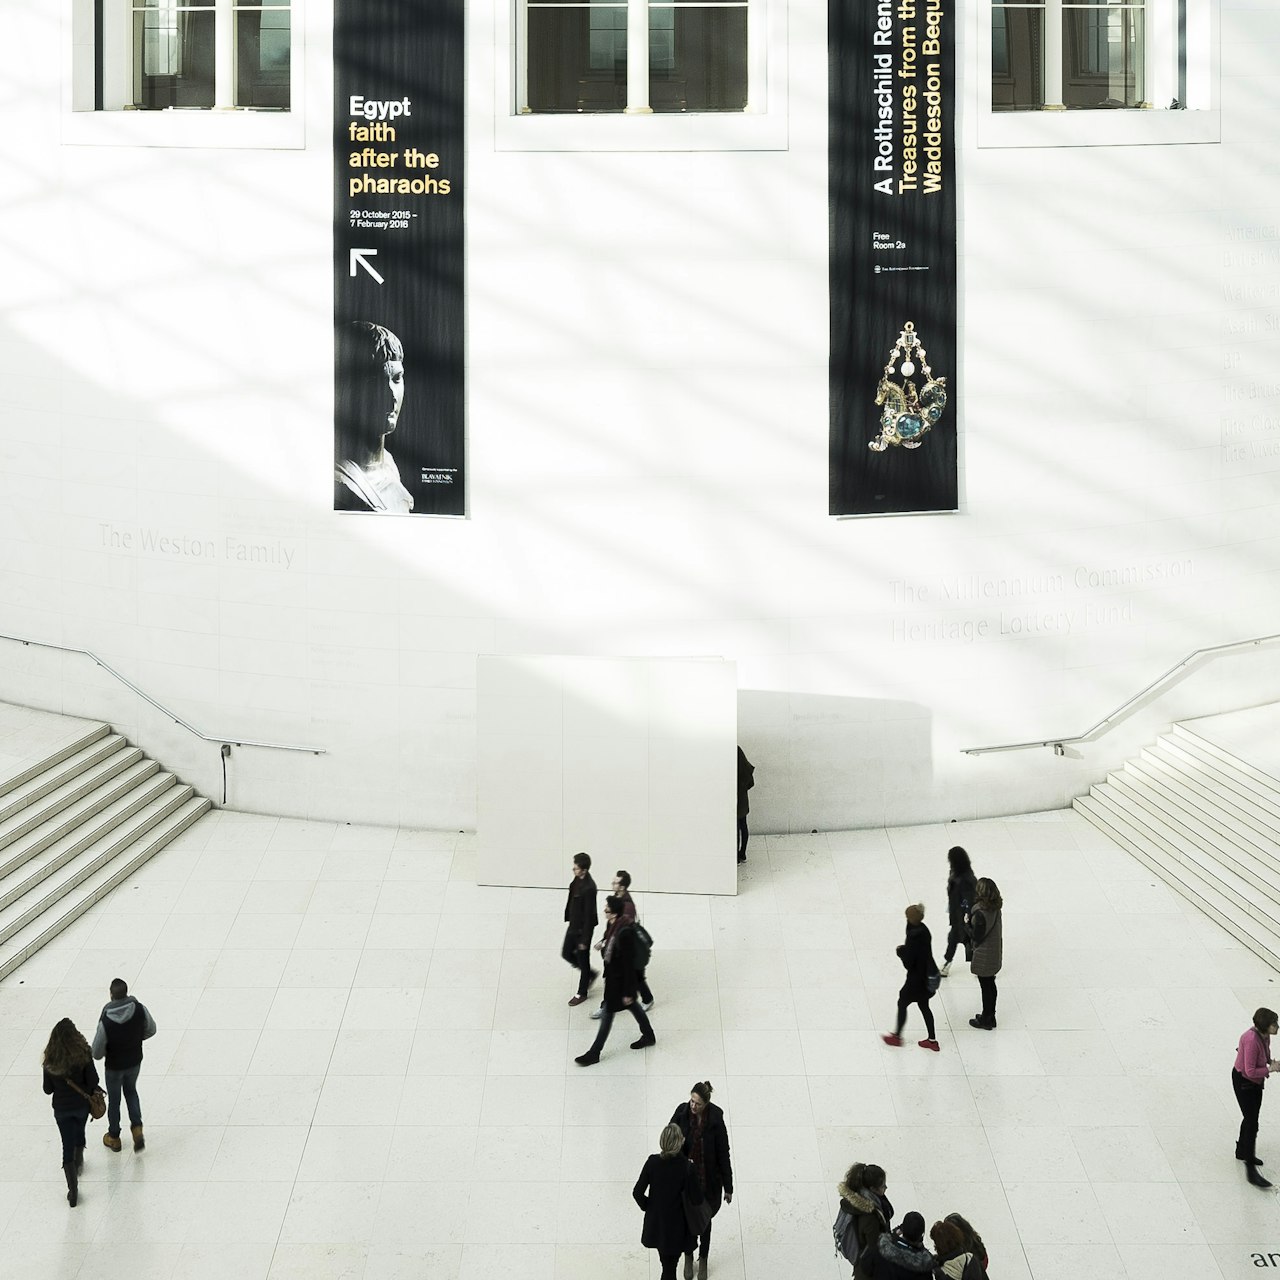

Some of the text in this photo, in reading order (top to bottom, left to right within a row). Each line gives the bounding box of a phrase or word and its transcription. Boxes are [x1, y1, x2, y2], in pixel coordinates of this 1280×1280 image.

[898, 26, 916, 78] from
[349, 95, 411, 121] Egypt
[873, 53, 893, 172] Rothschild
[349, 121, 396, 142] faith
[898, 84, 917, 195] Treasures
[922, 62, 943, 195] Waddesdon
[349, 148, 440, 168] after the
[349, 173, 451, 197] pharaohs
[873, 177, 893, 195] A
[350, 210, 411, 219] 29 October 2015
[350, 220, 409, 230] 7 February 2016
[873, 232, 890, 241] Free
[873, 241, 906, 249] Room 2a
[1223, 352, 1242, 370] BP
[98, 523, 296, 570] The Weston Family
[889, 555, 1195, 605] The Millennium Commission
[891, 599, 1134, 644] Heritage Lottery Fund
